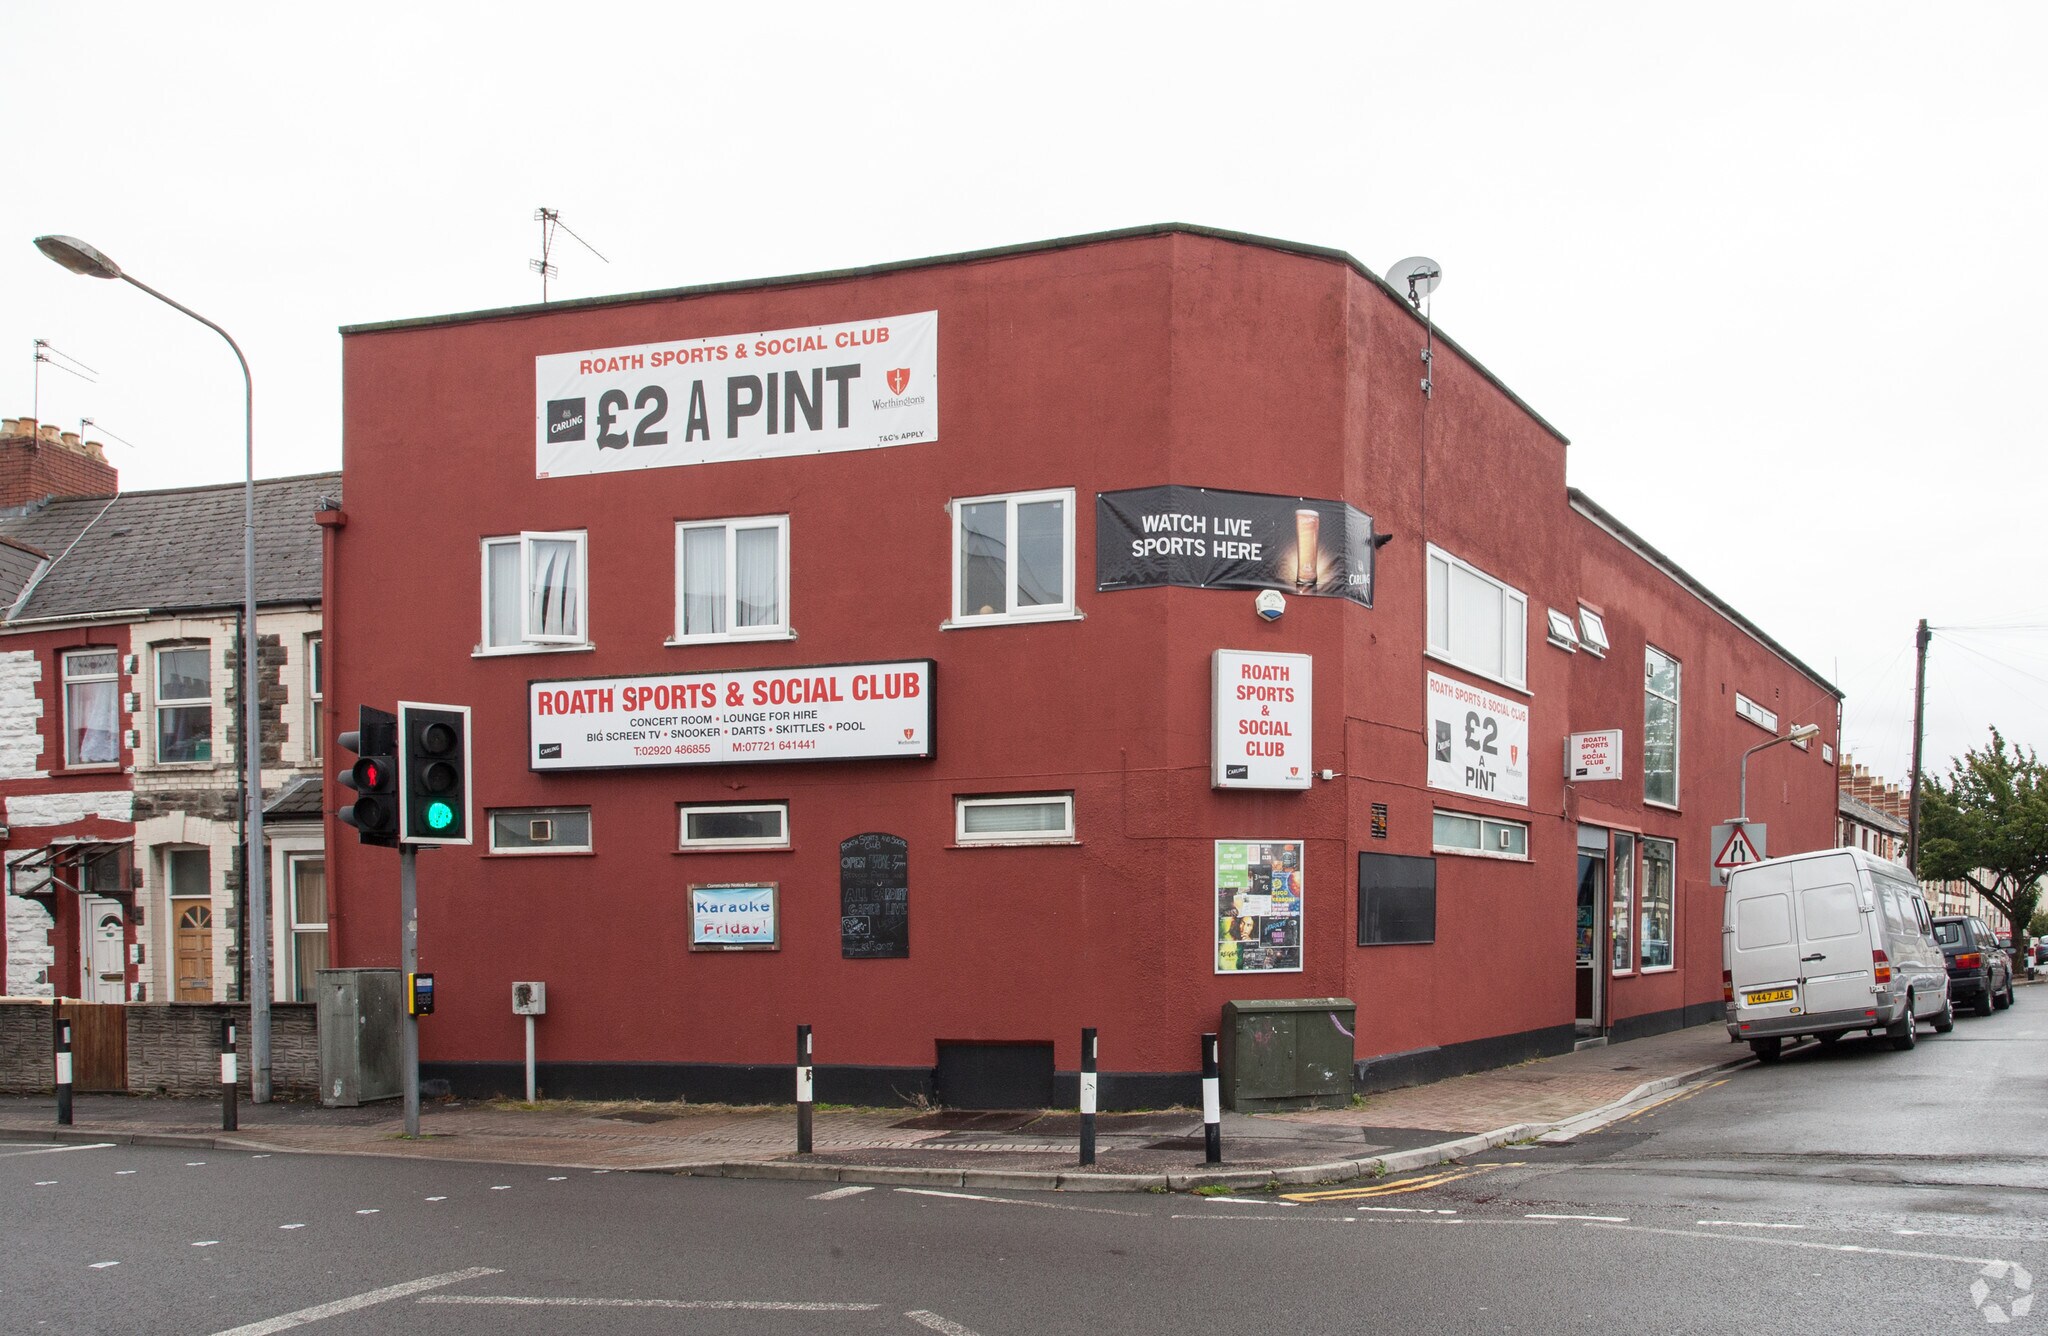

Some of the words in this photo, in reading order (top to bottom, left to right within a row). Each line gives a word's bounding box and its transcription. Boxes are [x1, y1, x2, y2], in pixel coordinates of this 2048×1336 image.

[580, 354, 644, 375] ROATH
[651, 345, 728, 368] SPORTS
[735, 344, 748, 358] &
[755, 335, 828, 356] SOCIAL
[835, 327, 890, 348] CLUB
[597, 384, 668, 450] £2
[685, 380, 710, 442] A
[727, 363, 861, 439] PINT
[872, 396, 925, 411] Worthington's
[551, 415, 583, 433] CARLING
[901, 430, 924, 440] APPLY
[1142, 513, 1206, 533] WATCH
[1214, 517, 1252, 537] LIVE
[1132, 537, 1206, 557] SPORTS
[1213, 541, 1262, 561] HERE
[1242, 664, 1290, 681] ROATH
[538, 688, 614, 716] ROATH
[622, 683, 716, 712] SPORTS
[725, 681, 744, 707] &
[752, 676, 843, 706] SOCIAL
[852, 672, 920, 701] CLUB
[1237, 685, 1294, 703] SPORTS
[1430, 679, 1453, 698] ROATH
[1455, 687, 1481, 707] SPORTS
[1482, 700, 1487, 709] &
[1488, 701, 1509, 717] SOCIAL
[1511, 707, 1526, 722] CLUB
[630, 716, 678, 727] CONCERT
[681, 715, 712, 725] ROOM
[723, 712, 766, 723] LOUNGE
[769, 711, 790, 720] FOR
[793, 710, 818, 720] HIRE
[1261, 705, 1270, 716] &
[587, 732, 604, 742] BIG
[606, 731, 646, 741] SCREEN
[649, 730, 661, 739] TV
[671, 728, 721, 738] SNOOKER
[731, 725, 766, 736] DARTS
[776, 723, 825, 734] SKITTLES
[836, 722, 866, 731] POOL
[1239, 719, 1292, 736] SOCIAL
[1465, 711, 1498, 756] £2
[634, 745, 672, 756] T:02920
[674, 744, 711, 754] 486855
[732, 742, 775, 752] M:07721
[779, 740, 816, 750] 641441
[1246, 741, 1285, 757] CLUB
[1479, 755, 1485, 767] A
[1466, 766, 1496, 792] PINT
[697, 901, 770, 913] Karaoke
[1750, 992, 1772, 1002] V447
[1774, 990, 1790, 1000] JAE
